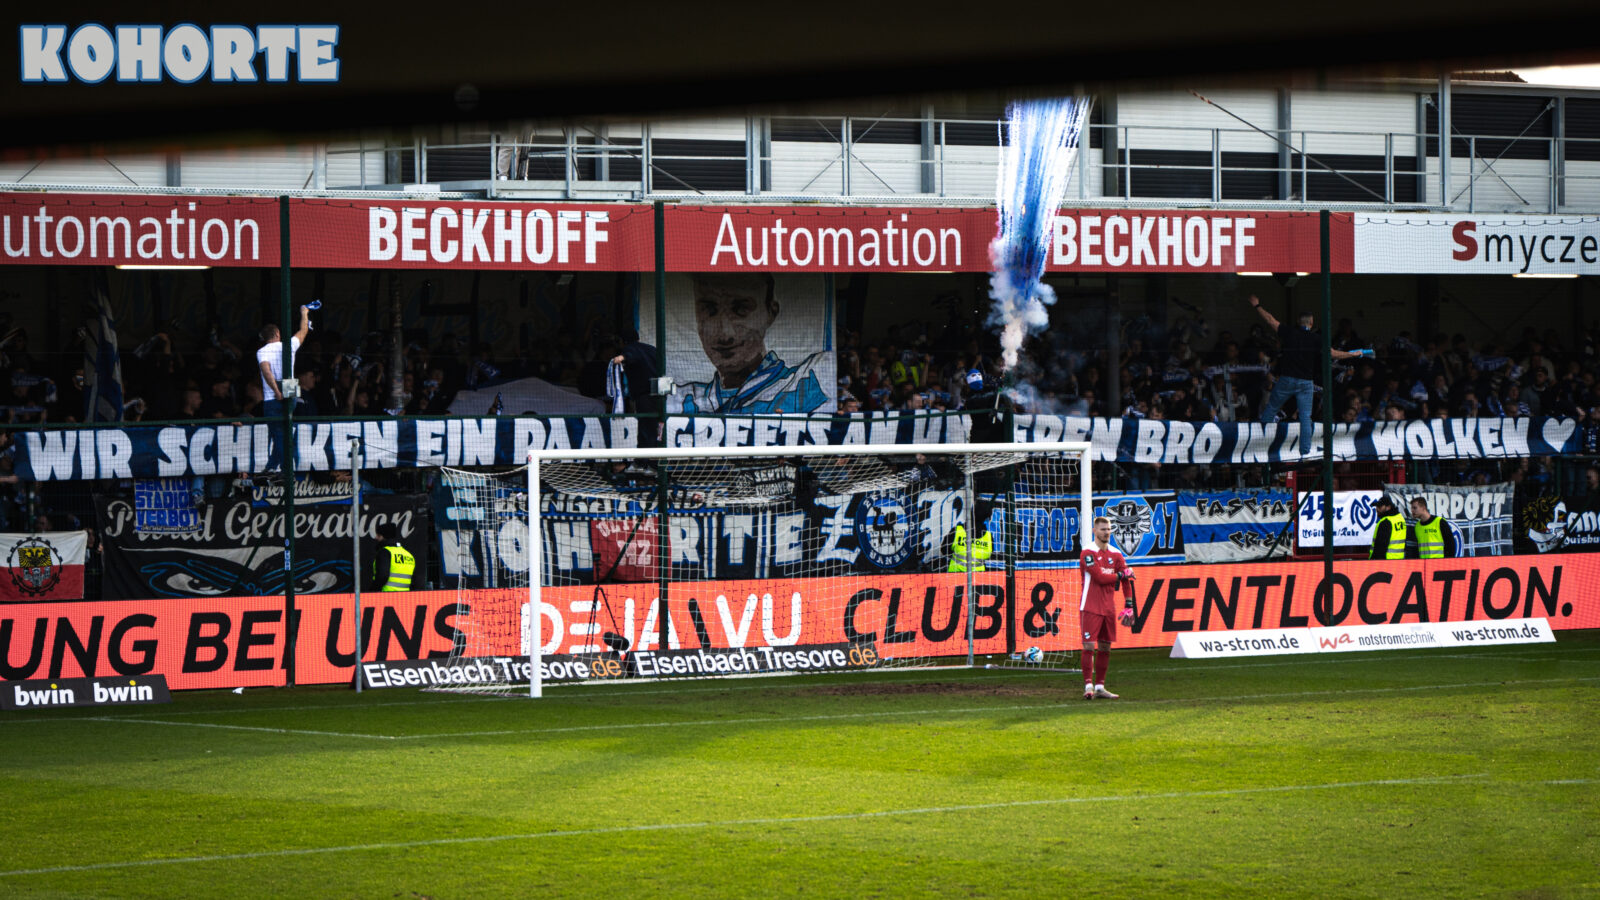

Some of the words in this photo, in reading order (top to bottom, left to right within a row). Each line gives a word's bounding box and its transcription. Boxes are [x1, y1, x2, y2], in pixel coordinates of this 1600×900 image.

[2, 203, 260, 260] utomation
[368, 207, 610, 264] BECKHOFF
[710, 213, 963, 267] Automation
[1053, 215, 1256, 267] BECKHOFF
[1452, 221, 1600, 272] Smycze
[26, 430, 132, 481] WIR
[157, 420, 398, 477] SCHIKEN
[415, 418, 497, 466] EIN
[666, 413, 832, 460] GREETS
[1135, 420, 1222, 463] BRO
[1231, 422, 1278, 463] IN
[1371, 417, 1530, 459] WOLKEN
[0, 613, 158, 680] UNG
[325, 604, 471, 668] UNS
[520, 598, 681, 656] DEJA
[716, 592, 802, 648] VU
[843, 588, 1006, 643] CLUB
[1023, 582, 1062, 638] &
[1115, 565, 1574, 635] VENTLOCATION.
[1359, 631, 1437, 646] notstromtechnik
[1452, 624, 1540, 642] wa-strom.de
[634, 649, 758, 676] Eisenbach
[1199, 634, 1299, 652] wa-strom.de
[93, 679, 153, 703] bwin
[364, 659, 497, 688] Eisenbach
[14, 682, 74, 706] bwin
